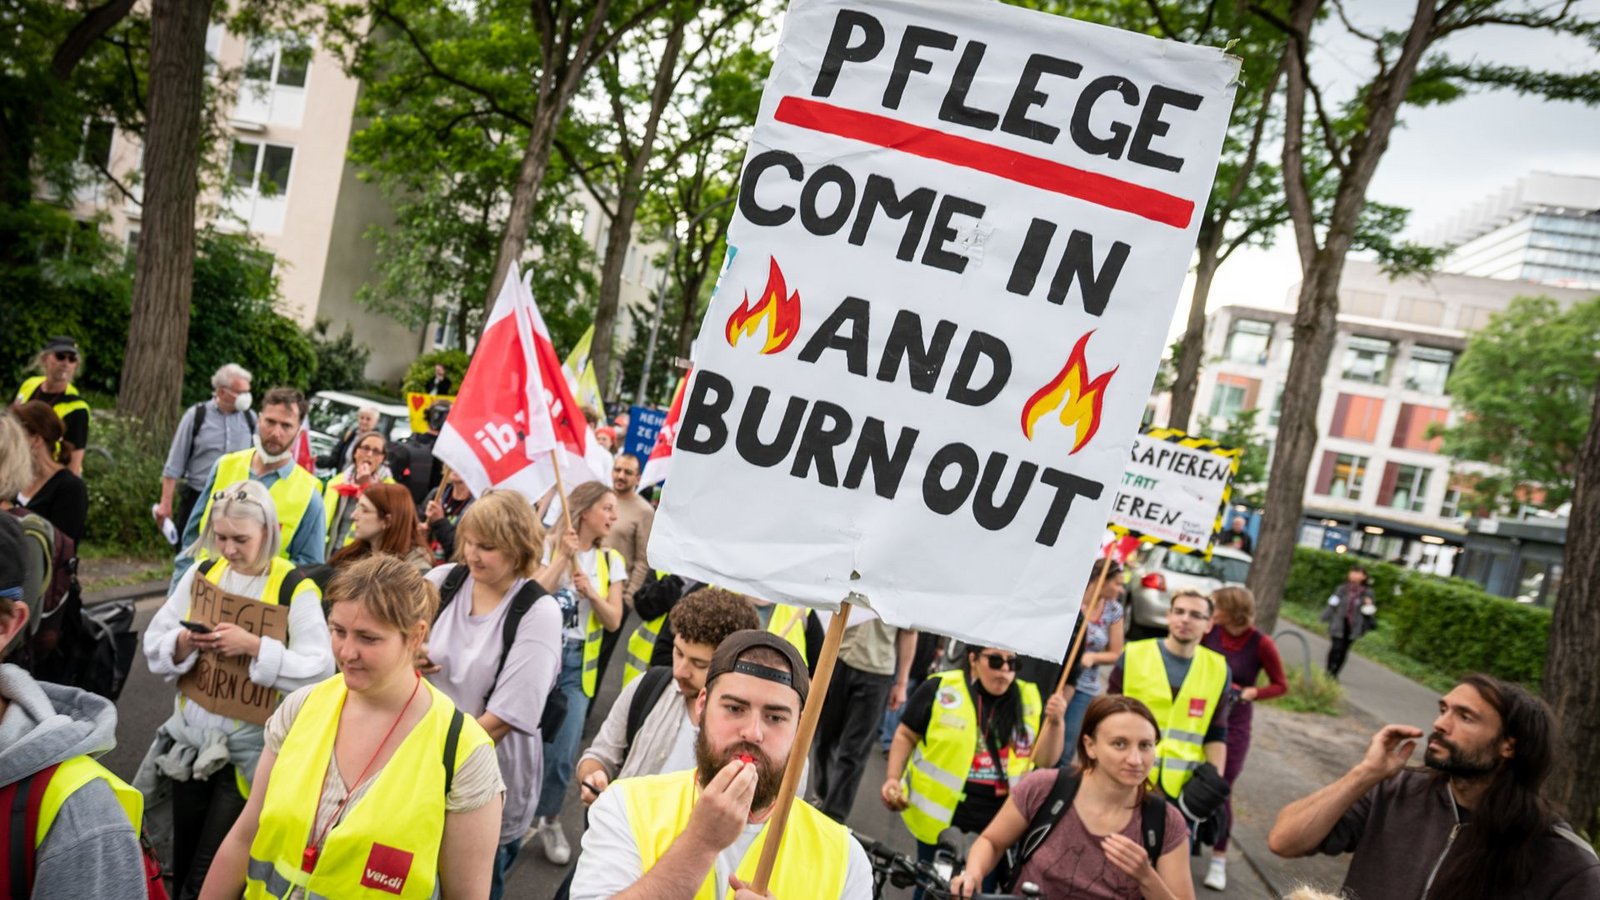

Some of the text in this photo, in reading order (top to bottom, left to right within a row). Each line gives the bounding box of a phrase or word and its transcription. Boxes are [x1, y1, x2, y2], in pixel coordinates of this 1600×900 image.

[811, 9, 1204, 173] PFLEGE
[738, 149, 1131, 316] COME IN
[798, 296, 1013, 406] AND
[676, 369, 1104, 547] BURN OUT
[1122, 472, 1160, 490] TATT
[196, 658, 238, 700] BURN
[366, 868, 403, 889] ver.di
